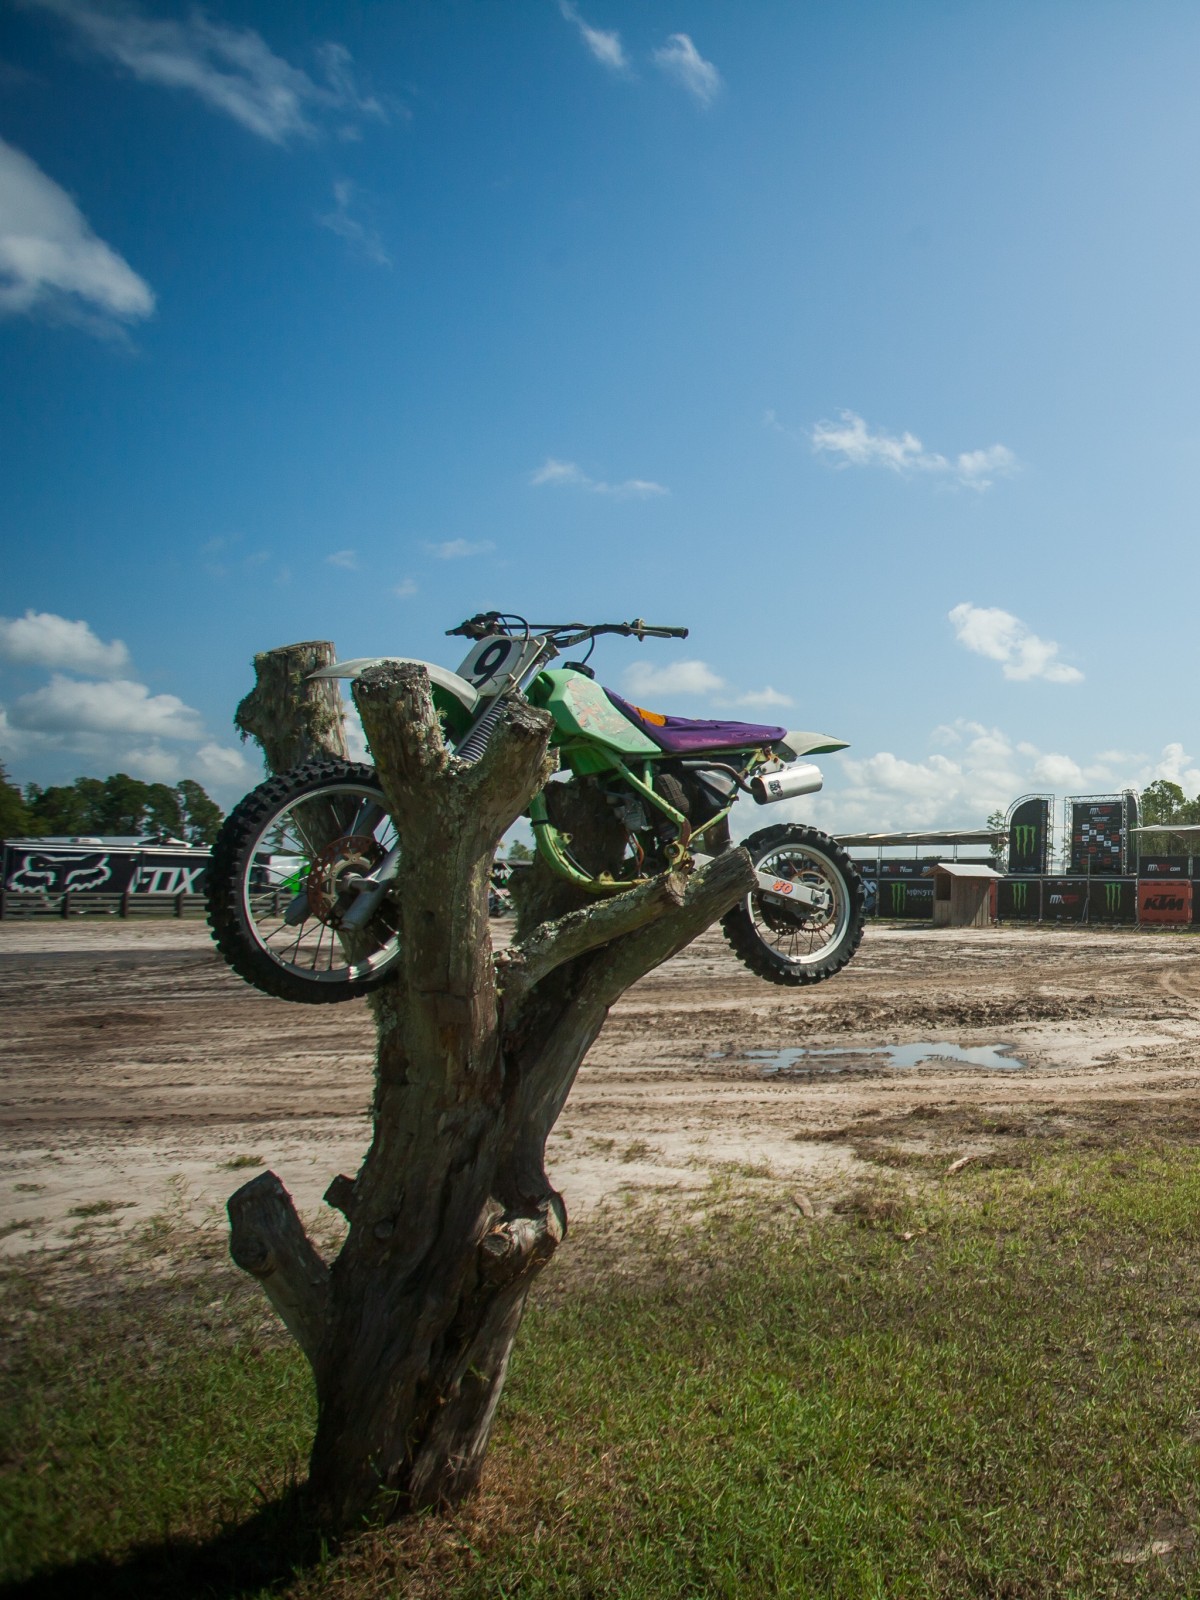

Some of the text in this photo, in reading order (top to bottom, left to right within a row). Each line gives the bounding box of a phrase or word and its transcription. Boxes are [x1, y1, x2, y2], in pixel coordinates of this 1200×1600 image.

[466, 639, 512, 689] 9
[129, 866, 204, 894] FOX
[907, 888, 935, 897] MONSTE
[1143, 894, 1184, 911] KTM
